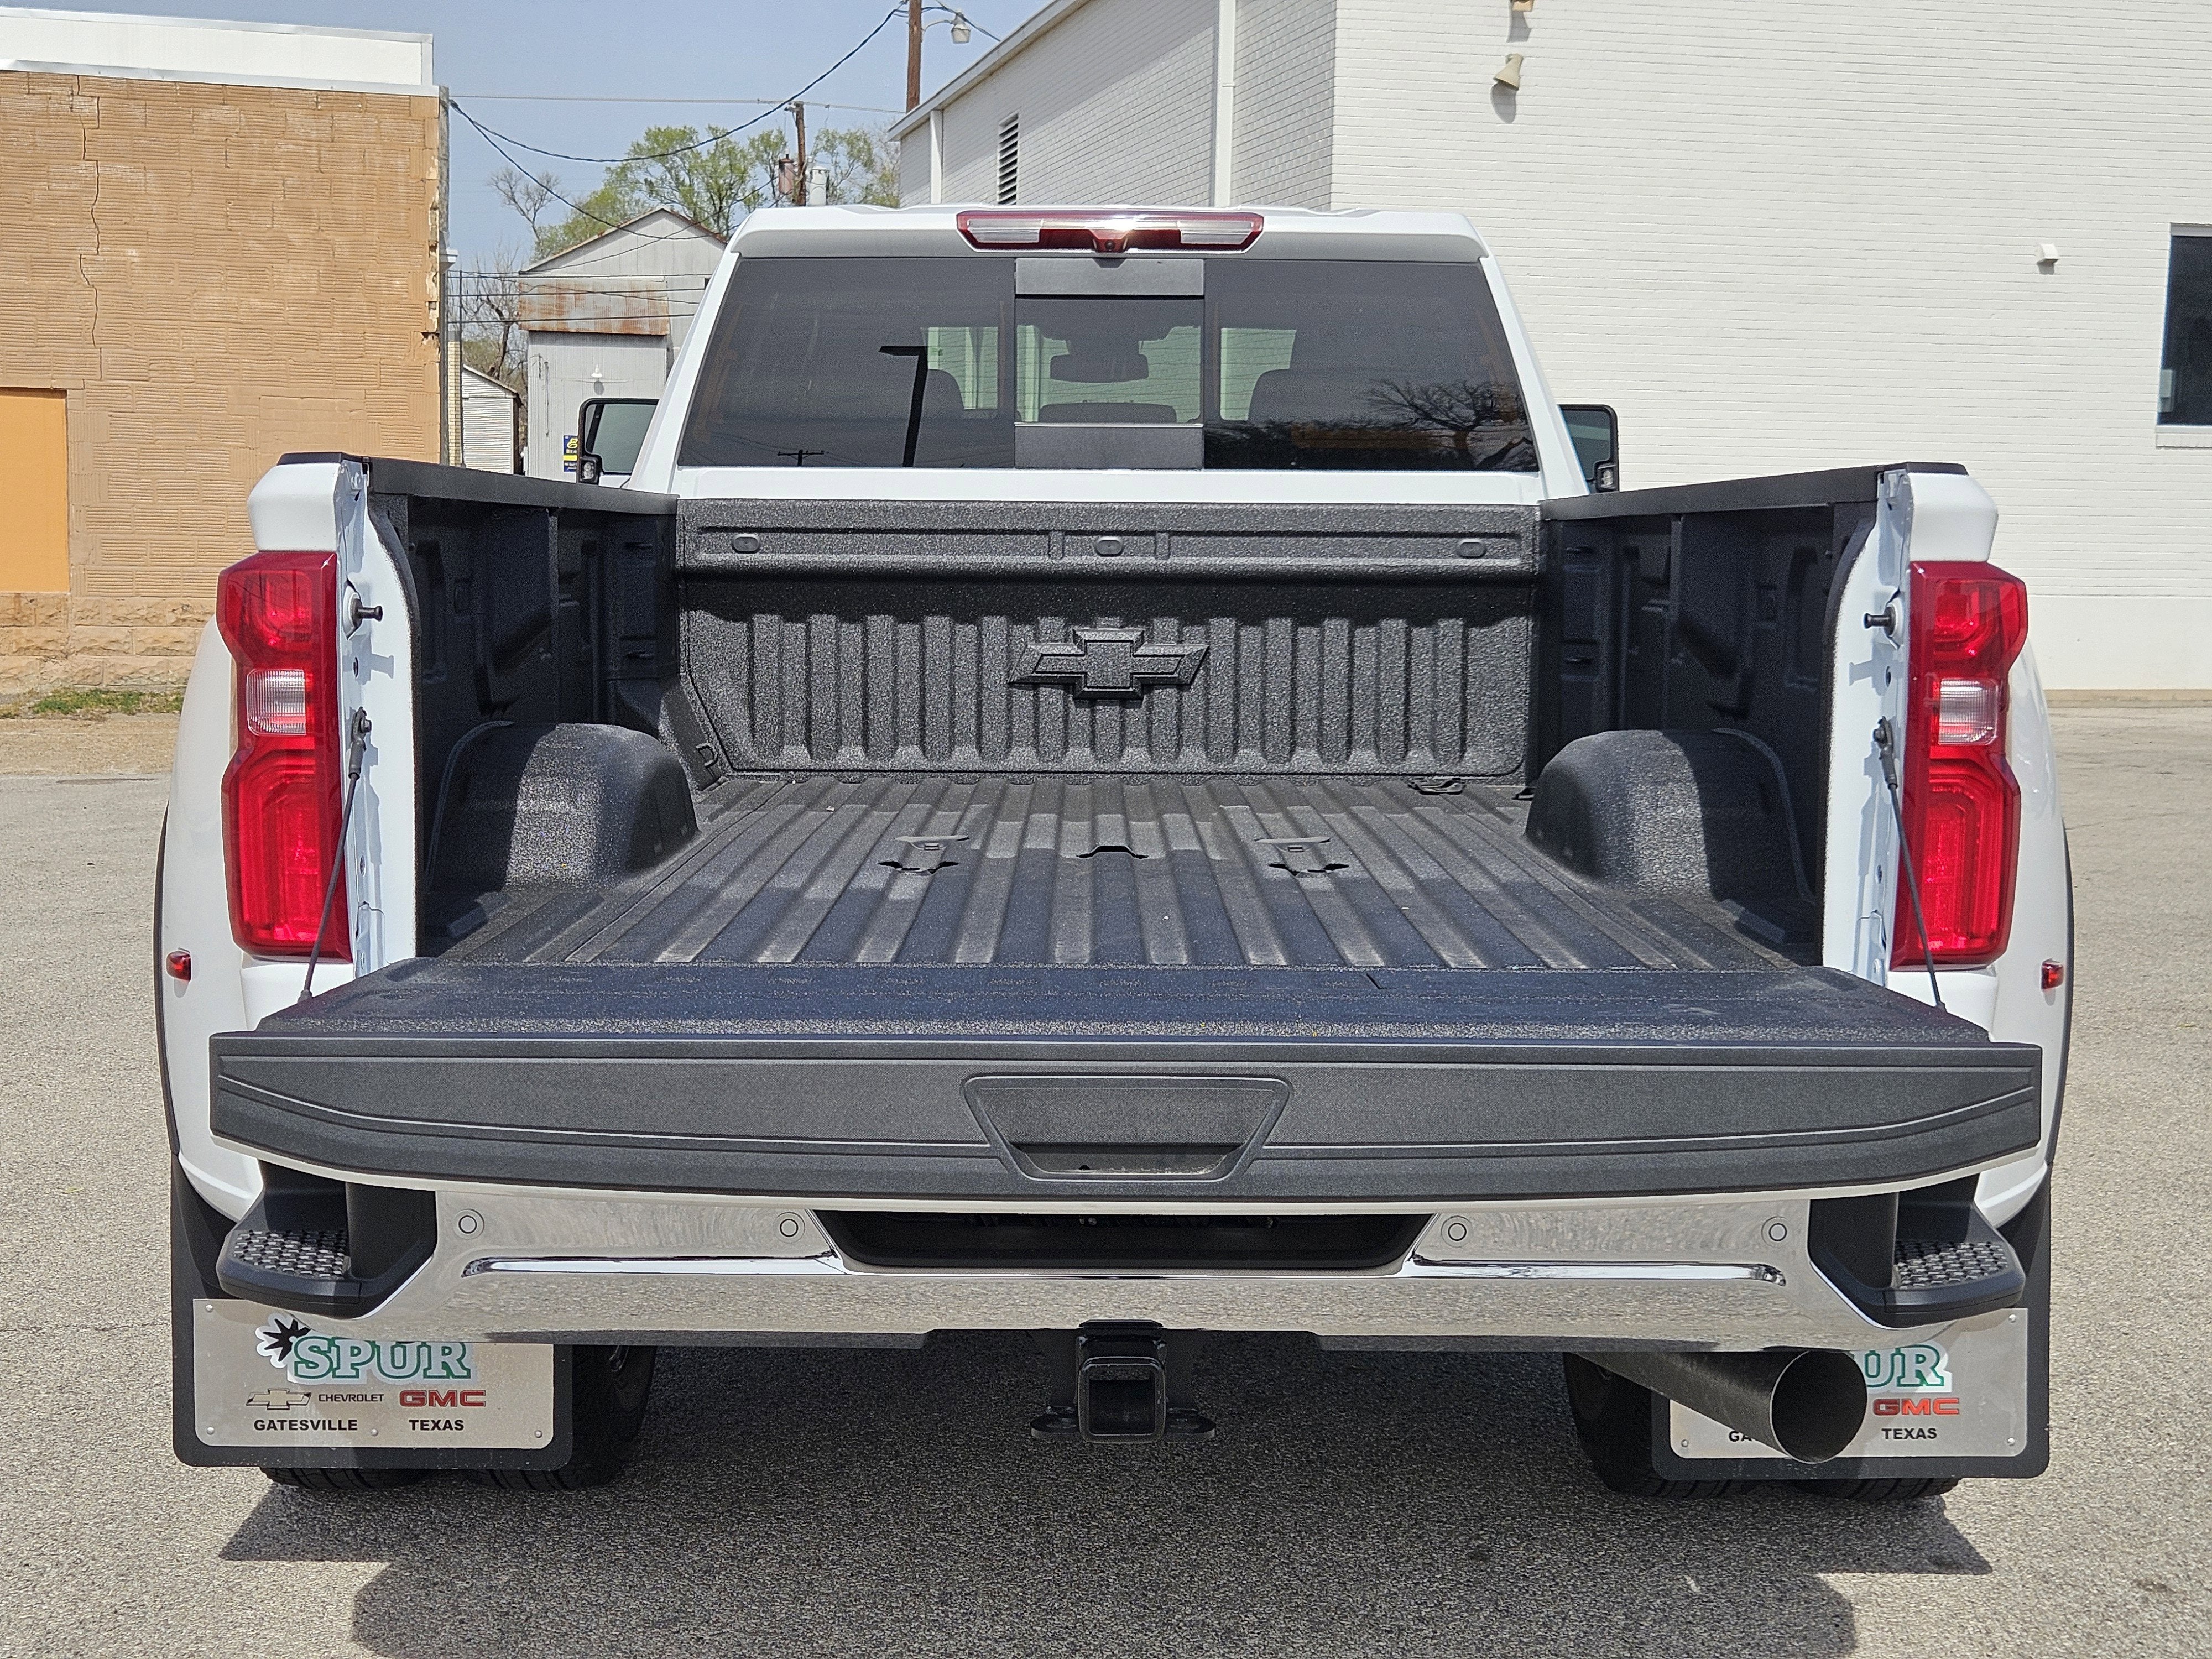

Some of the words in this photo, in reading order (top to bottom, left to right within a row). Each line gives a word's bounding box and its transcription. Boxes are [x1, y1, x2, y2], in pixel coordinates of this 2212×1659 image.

[293, 1335, 471, 1379] SPUR
[1850, 1344, 1945, 1387] UR
[318, 1392, 385, 1403] CHEVROLET
[399, 1390, 487, 1407] GMC
[1872, 1397, 1960, 1416] GMC
[253, 1418, 358, 1432] GATESVILLE
[408, 1419, 465, 1431] TEXAS
[1881, 1427, 1937, 1440] TEXAS
